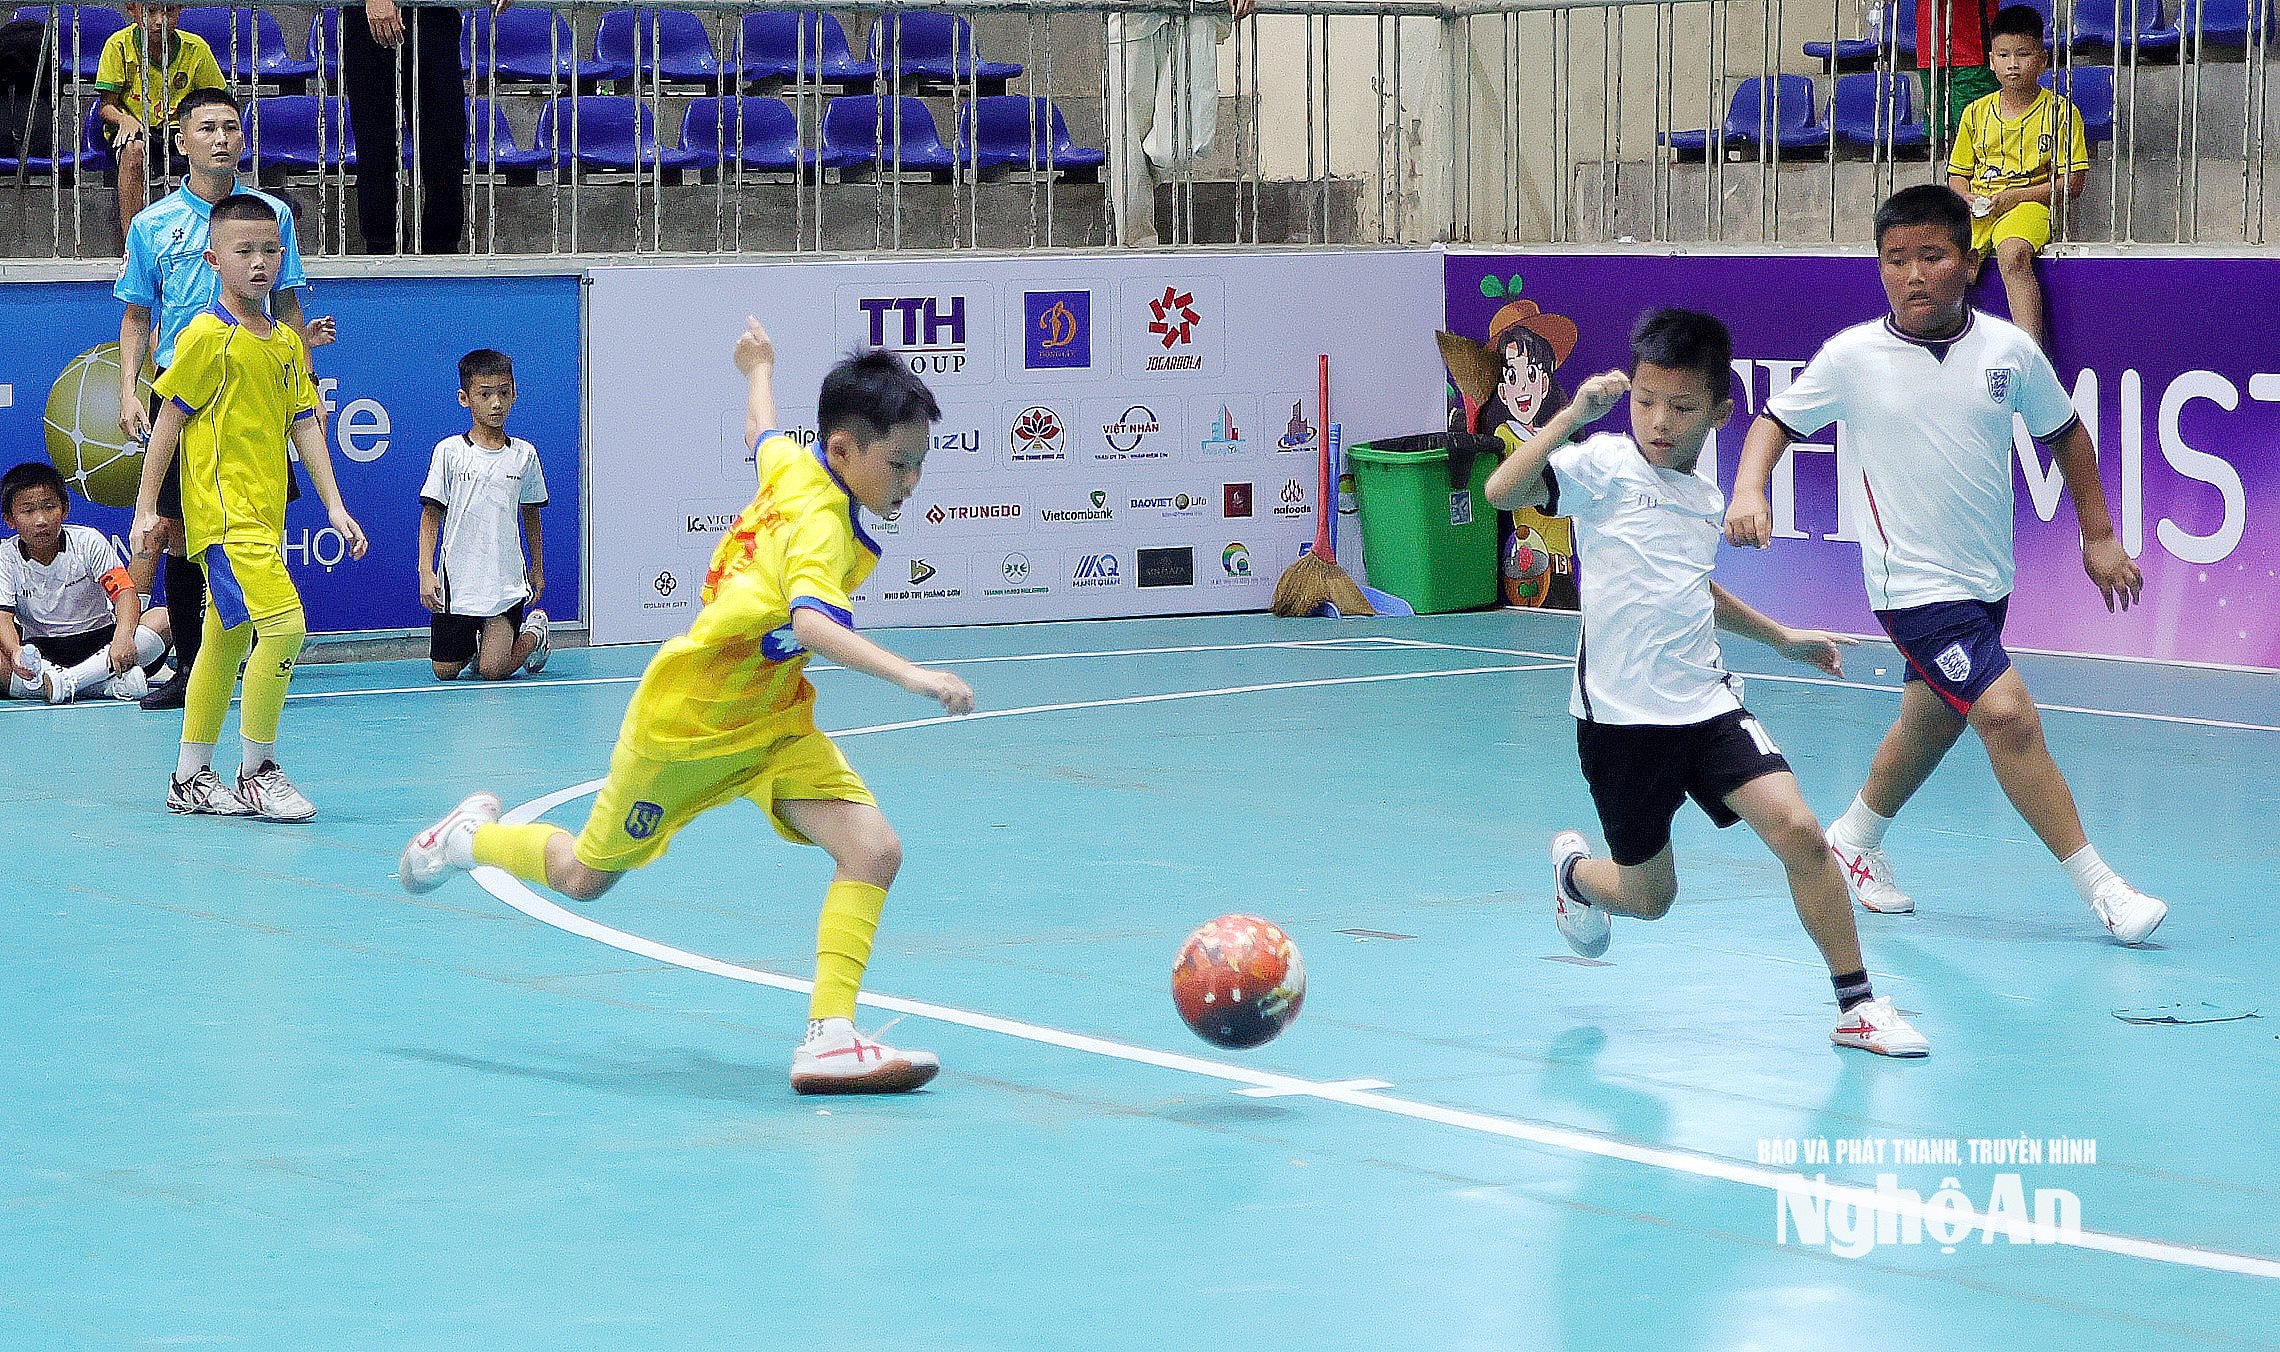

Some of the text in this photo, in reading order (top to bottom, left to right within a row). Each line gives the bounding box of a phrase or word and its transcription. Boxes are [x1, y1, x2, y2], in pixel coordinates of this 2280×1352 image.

[860, 297, 966, 347] TTH
[910, 355, 966, 374] OUP
[949, 504, 1021, 519] TRUNGDO
[1041, 507, 1113, 522] Vietcombank
[1273, 505, 1312, 515] nafoods
